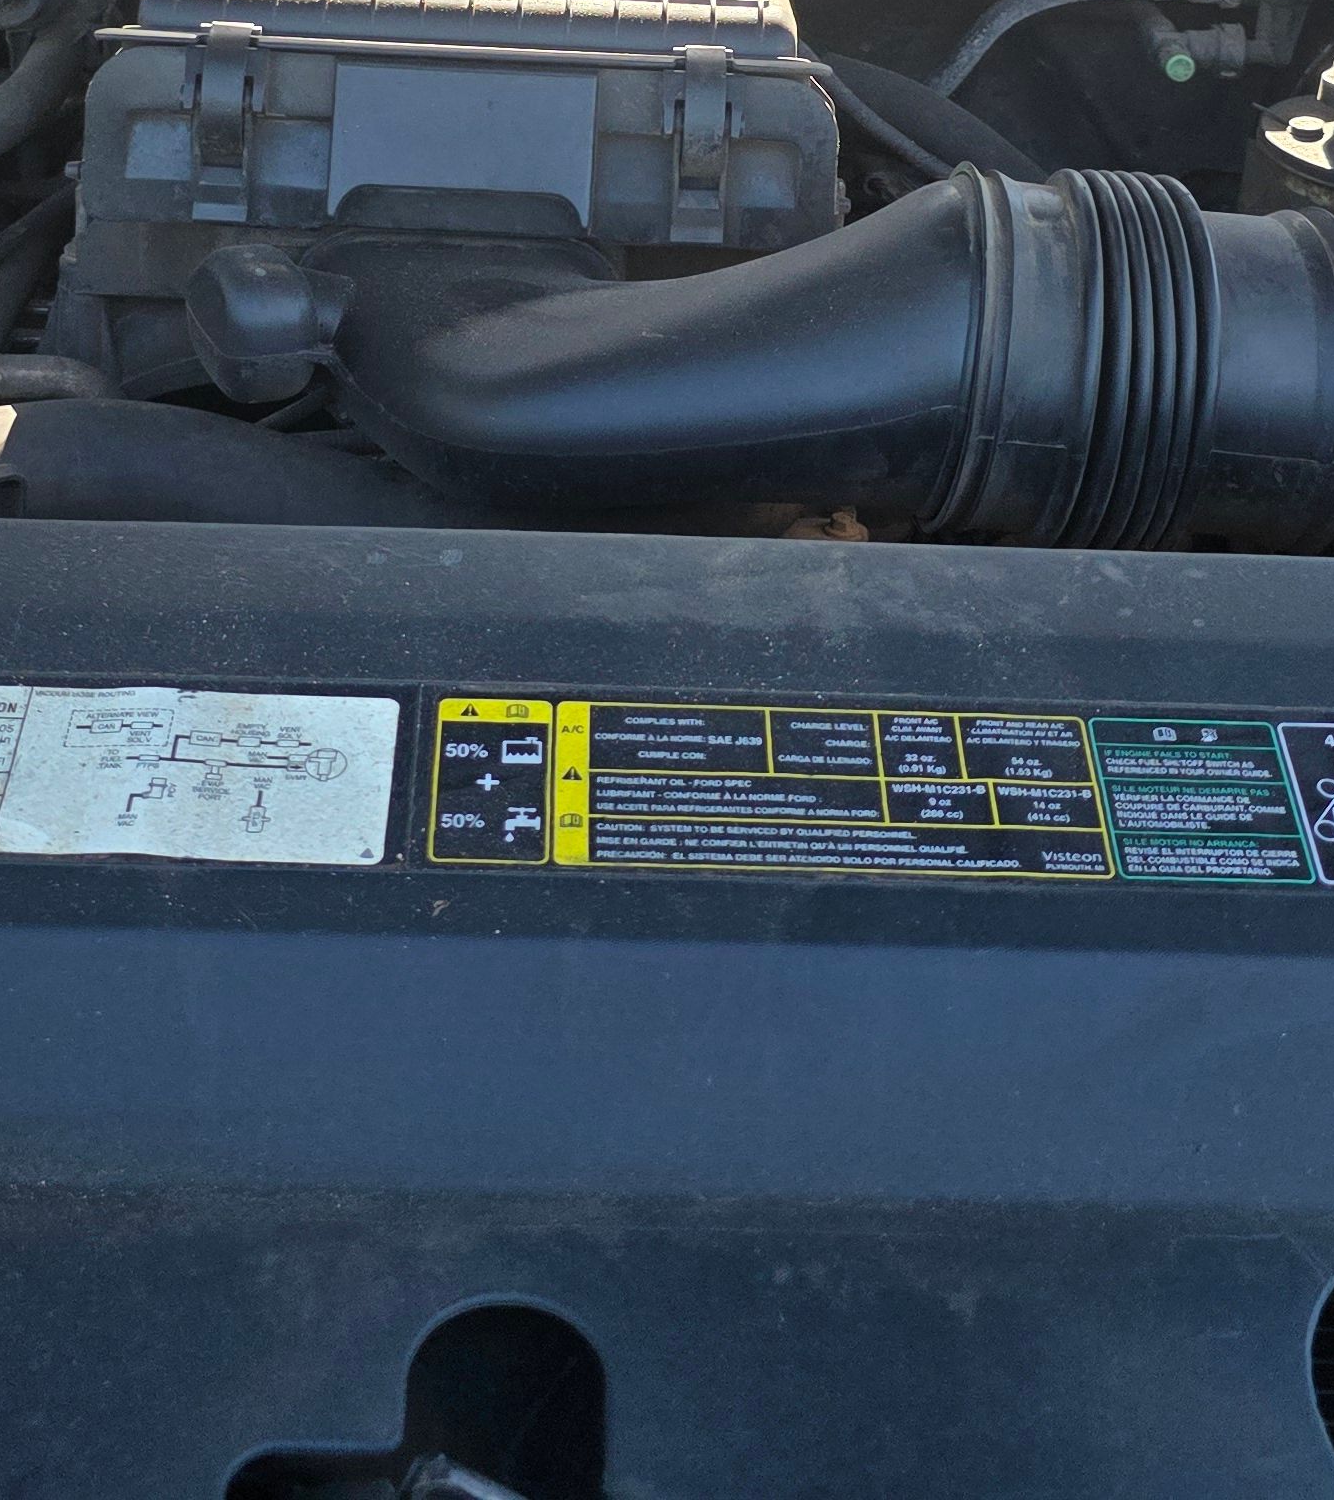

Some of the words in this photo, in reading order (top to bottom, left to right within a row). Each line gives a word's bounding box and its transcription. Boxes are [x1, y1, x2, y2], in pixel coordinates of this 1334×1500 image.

[98, 690, 136, 698] ROUTING
[561, 725, 585, 733] A/C
[196, 734, 216, 742] CAN
[708, 735, 733, 745] SAE
[735, 736, 763, 746] J639
[445, 743, 489, 758] 50%
[724, 779, 752, 788] SPEC
[441, 814, 485, 828] 50%
[1041, 850, 1103, 862] Visteon
